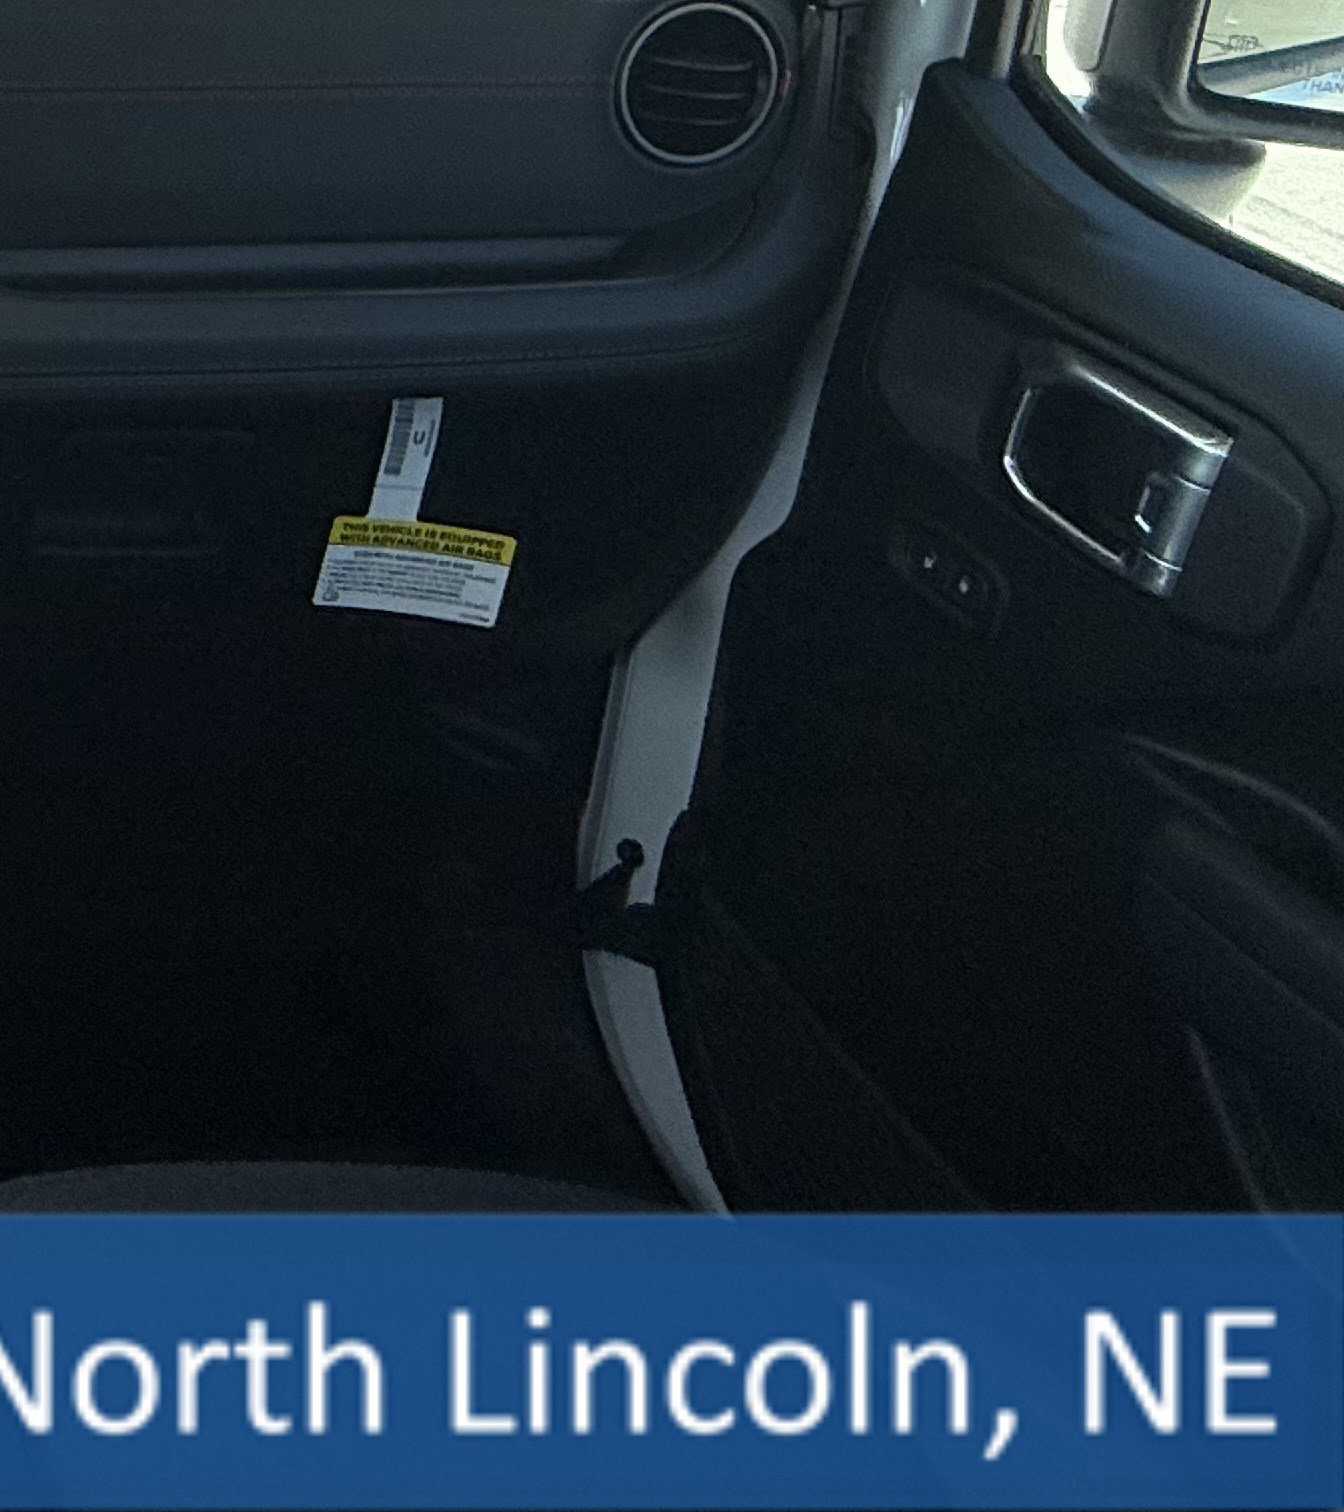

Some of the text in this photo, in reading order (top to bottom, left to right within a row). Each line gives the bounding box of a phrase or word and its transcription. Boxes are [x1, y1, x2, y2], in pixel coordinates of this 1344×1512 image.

[342, 521, 370, 534] THIS
[372, 523, 422, 538] VEHICLE
[372, 535, 440, 552] ADVANCED
[442, 543, 462, 555] AIR
[466, 547, 502, 561] BAGS
